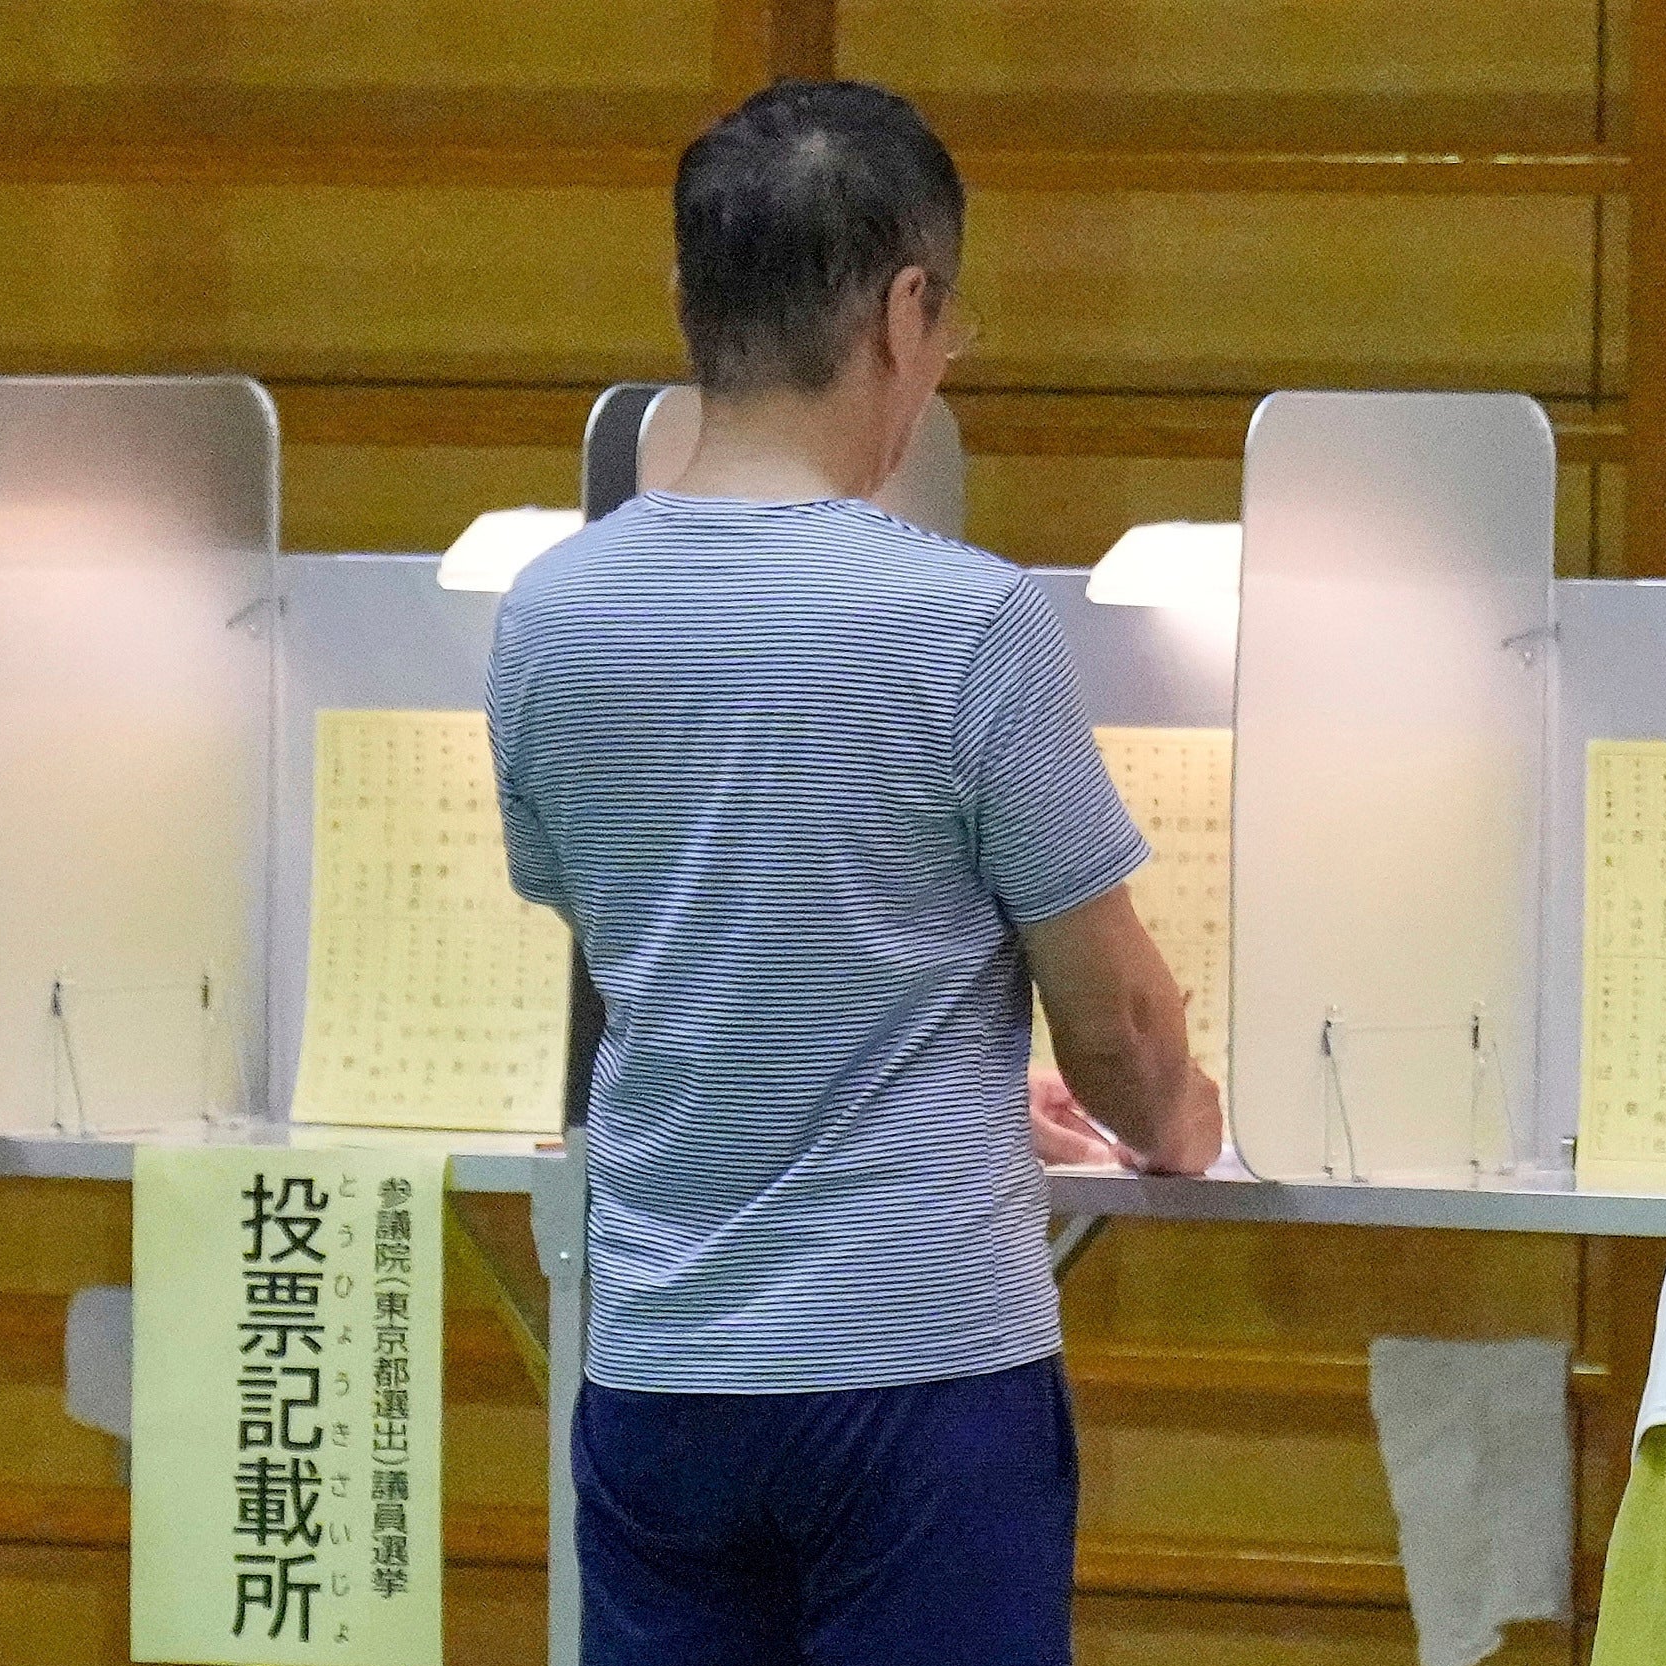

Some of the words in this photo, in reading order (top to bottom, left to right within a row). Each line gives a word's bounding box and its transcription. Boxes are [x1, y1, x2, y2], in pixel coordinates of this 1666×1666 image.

[232, 1173, 329, 1643] 投票記載所
